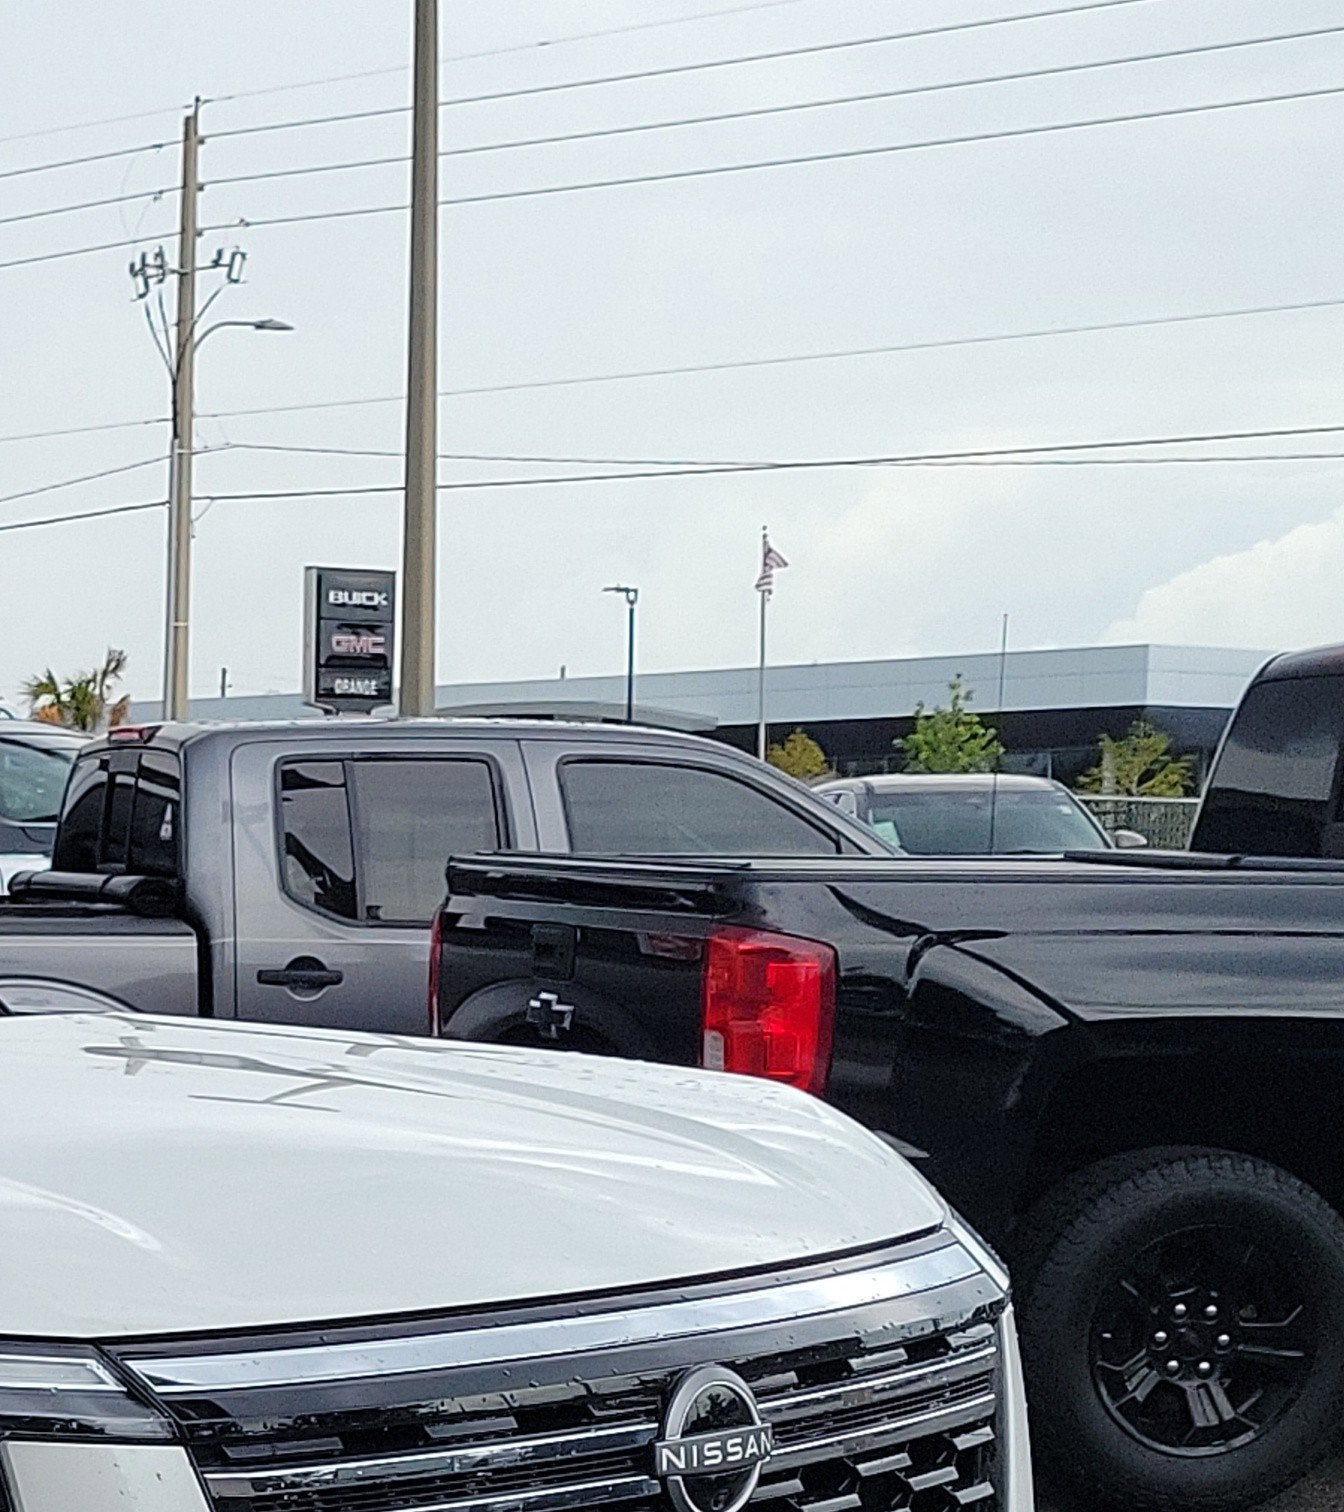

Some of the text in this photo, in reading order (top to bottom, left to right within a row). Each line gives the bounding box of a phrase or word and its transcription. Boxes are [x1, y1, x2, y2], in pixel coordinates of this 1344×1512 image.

[328, 589, 388, 606] BUICK
[331, 634, 386, 654] GMC
[661, 1430, 772, 1473] NISSAN
